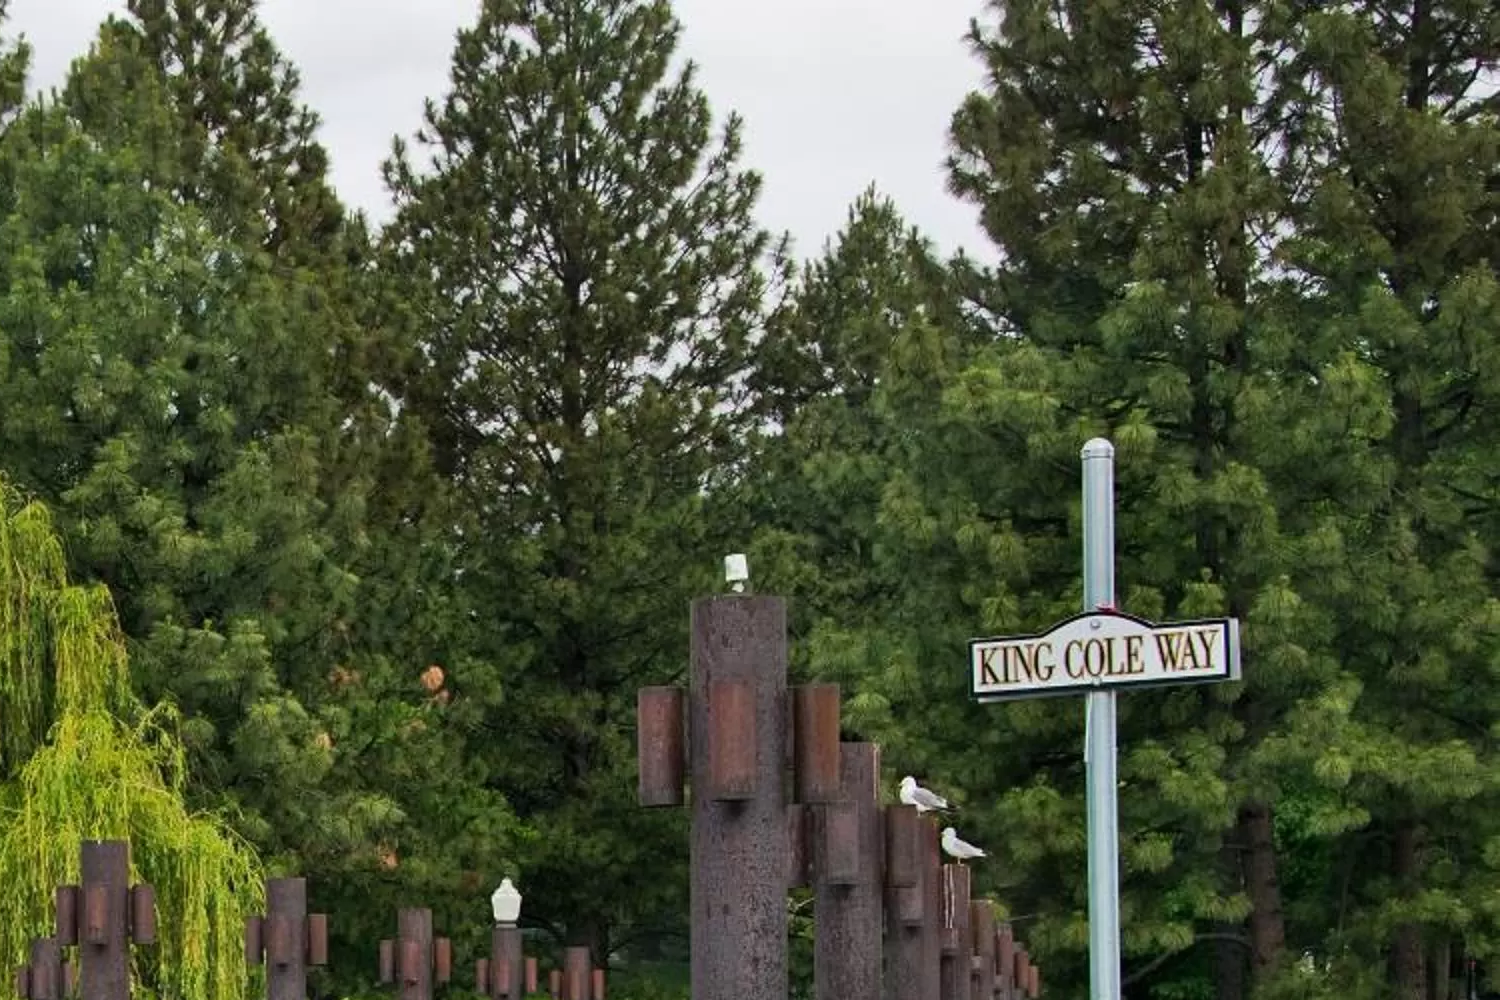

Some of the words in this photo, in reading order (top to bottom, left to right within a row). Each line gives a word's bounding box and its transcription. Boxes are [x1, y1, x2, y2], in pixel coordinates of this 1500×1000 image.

[977, 641, 1056, 685] KING
[1064, 635, 1146, 679] COLE
[1153, 629, 1221, 671] WAY
